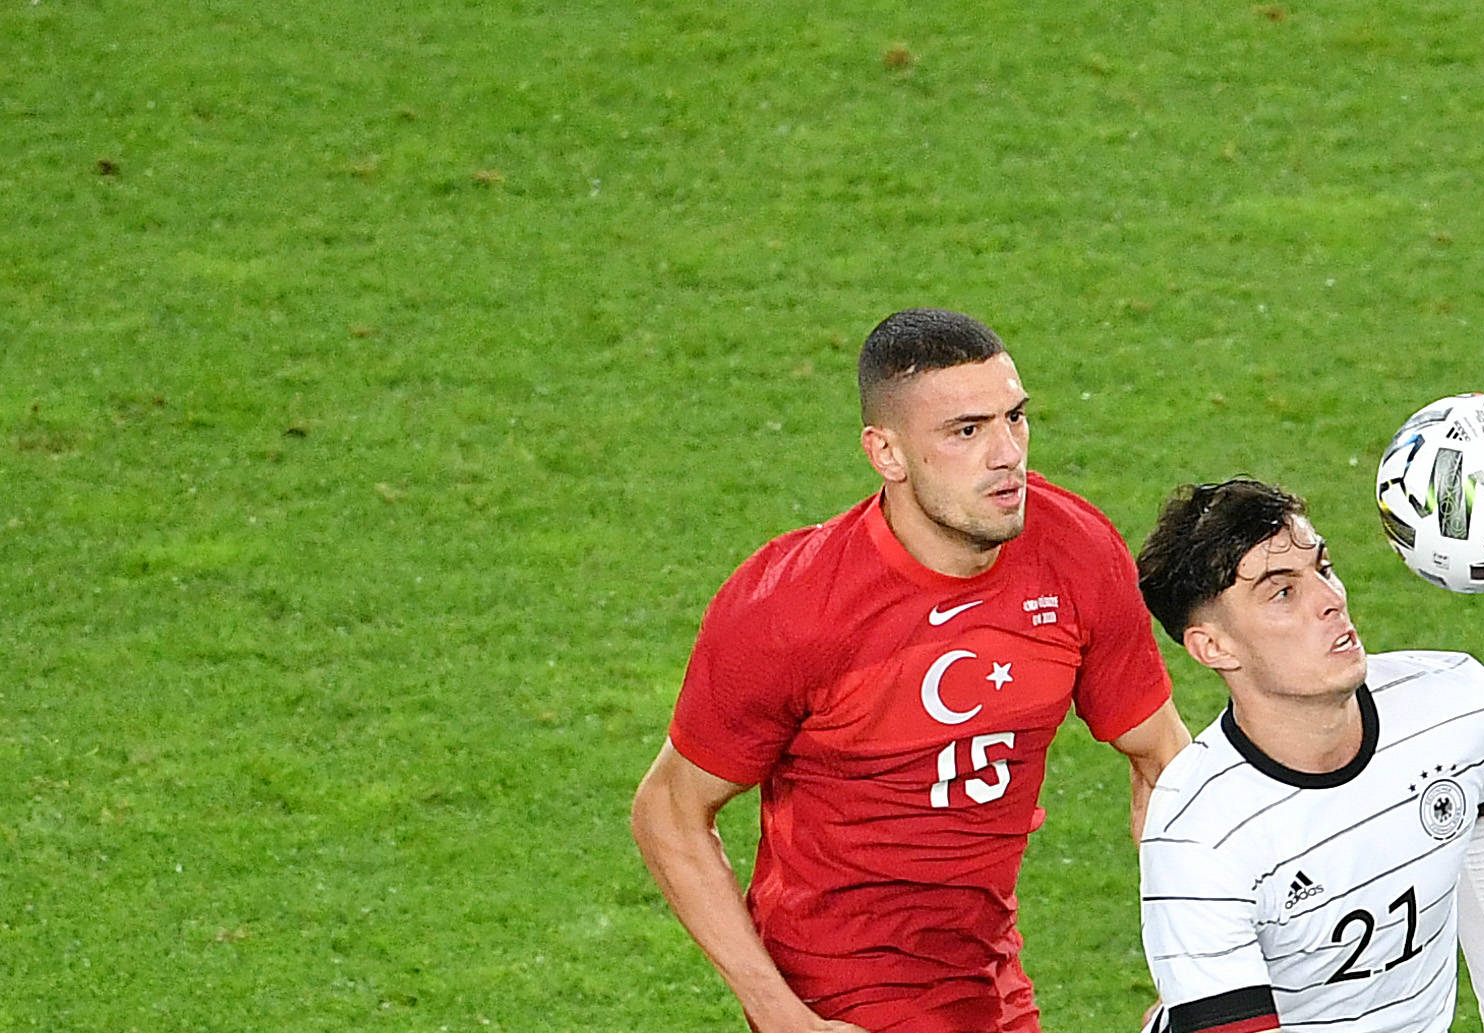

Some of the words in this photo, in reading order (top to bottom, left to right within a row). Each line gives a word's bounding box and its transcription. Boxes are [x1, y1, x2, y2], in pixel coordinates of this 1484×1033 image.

[930, 732, 1015, 808] 15
[1284, 884, 1325, 910] adidas
[1324, 885, 1423, 986] 21
